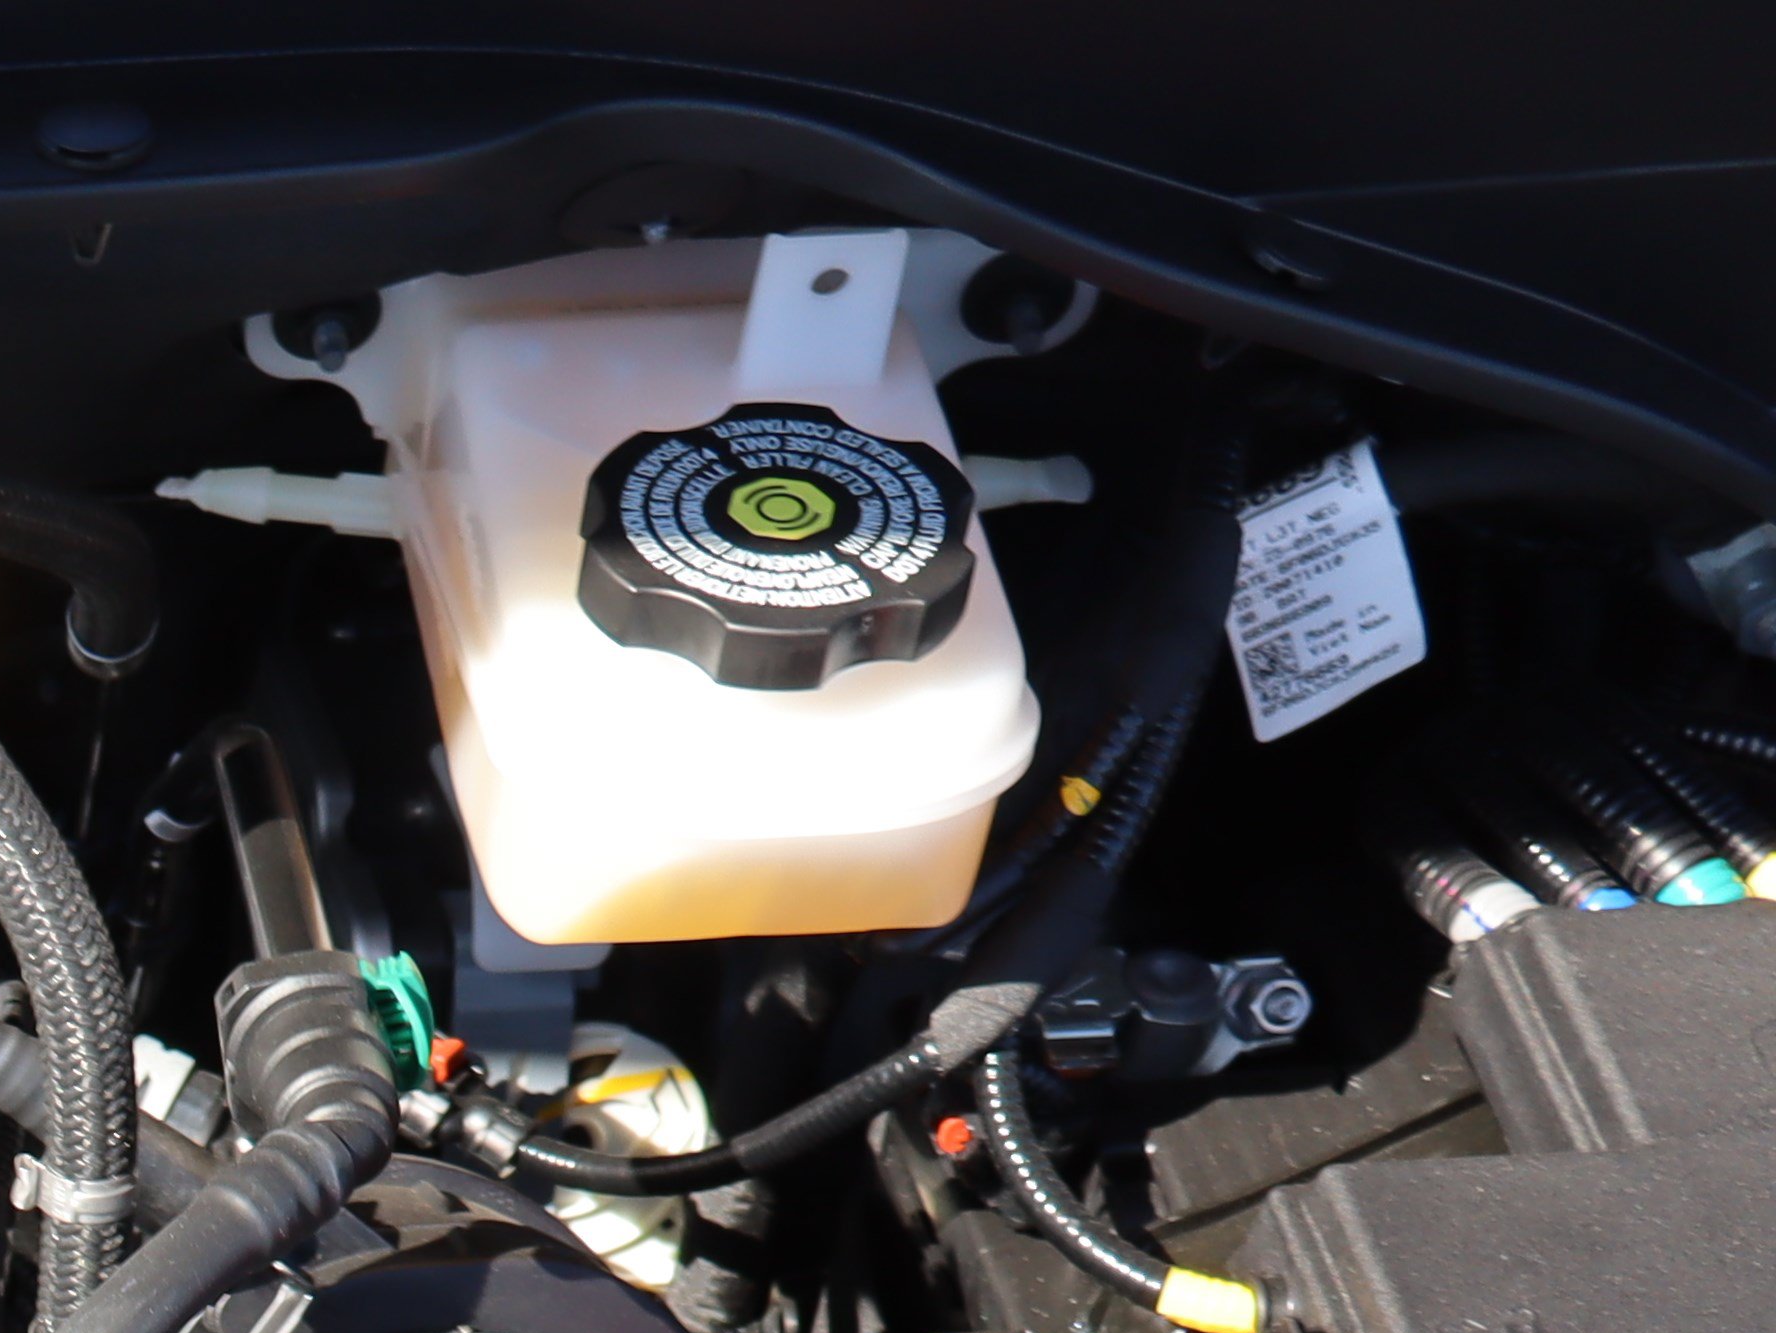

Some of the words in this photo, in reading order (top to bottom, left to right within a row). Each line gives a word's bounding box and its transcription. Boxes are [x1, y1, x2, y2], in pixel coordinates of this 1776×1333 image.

[671, 452, 709, 475] DOT
[740, 452, 815, 471] FILLER
[833, 427, 913, 468] SEALED
[619, 475, 654, 509] AVANT
[650, 469, 689, 501] FREIN
[904, 472, 942, 510] FROM
[649, 501, 674, 516] DE
[877, 494, 916, 545] BEFORE
[619, 510, 670, 564] BOUCHON
[909, 513, 943, 550] FLUID
[649, 556, 684, 577] LE
[852, 539, 904, 571] CAP
[878, 552, 926, 583] DOT
